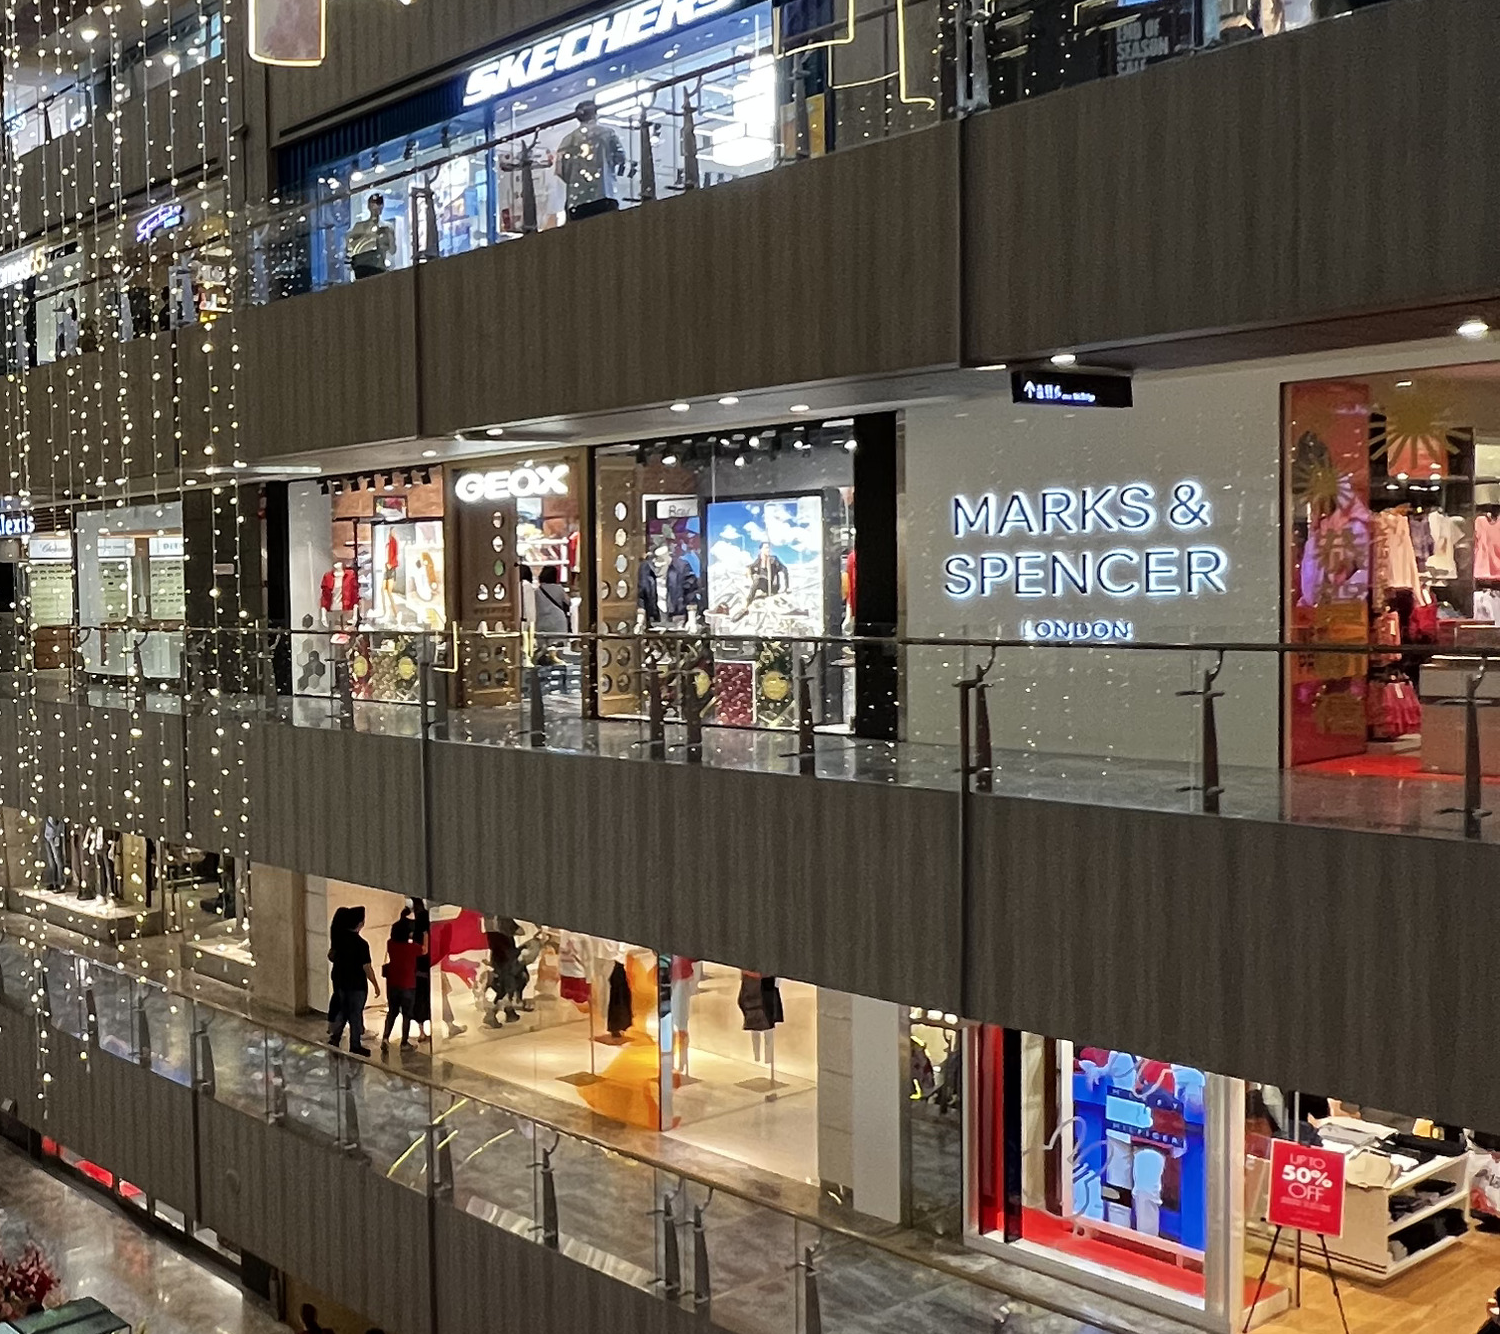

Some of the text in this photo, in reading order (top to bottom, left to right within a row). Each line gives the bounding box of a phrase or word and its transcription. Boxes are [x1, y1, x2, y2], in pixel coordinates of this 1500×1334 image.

[1116, 36, 1169, 60] SEASON
[455, 464, 569, 503] GEOX
[953, 479, 1213, 537] MARKS &
[944, 547, 1227, 599] SPENCER
[1023, 619, 1133, 641] LONDON
[1289, 1153, 1326, 1170] UP TO
[1282, 1164, 1333, 1188] 50%
[1288, 1182, 1325, 1202] OFF
